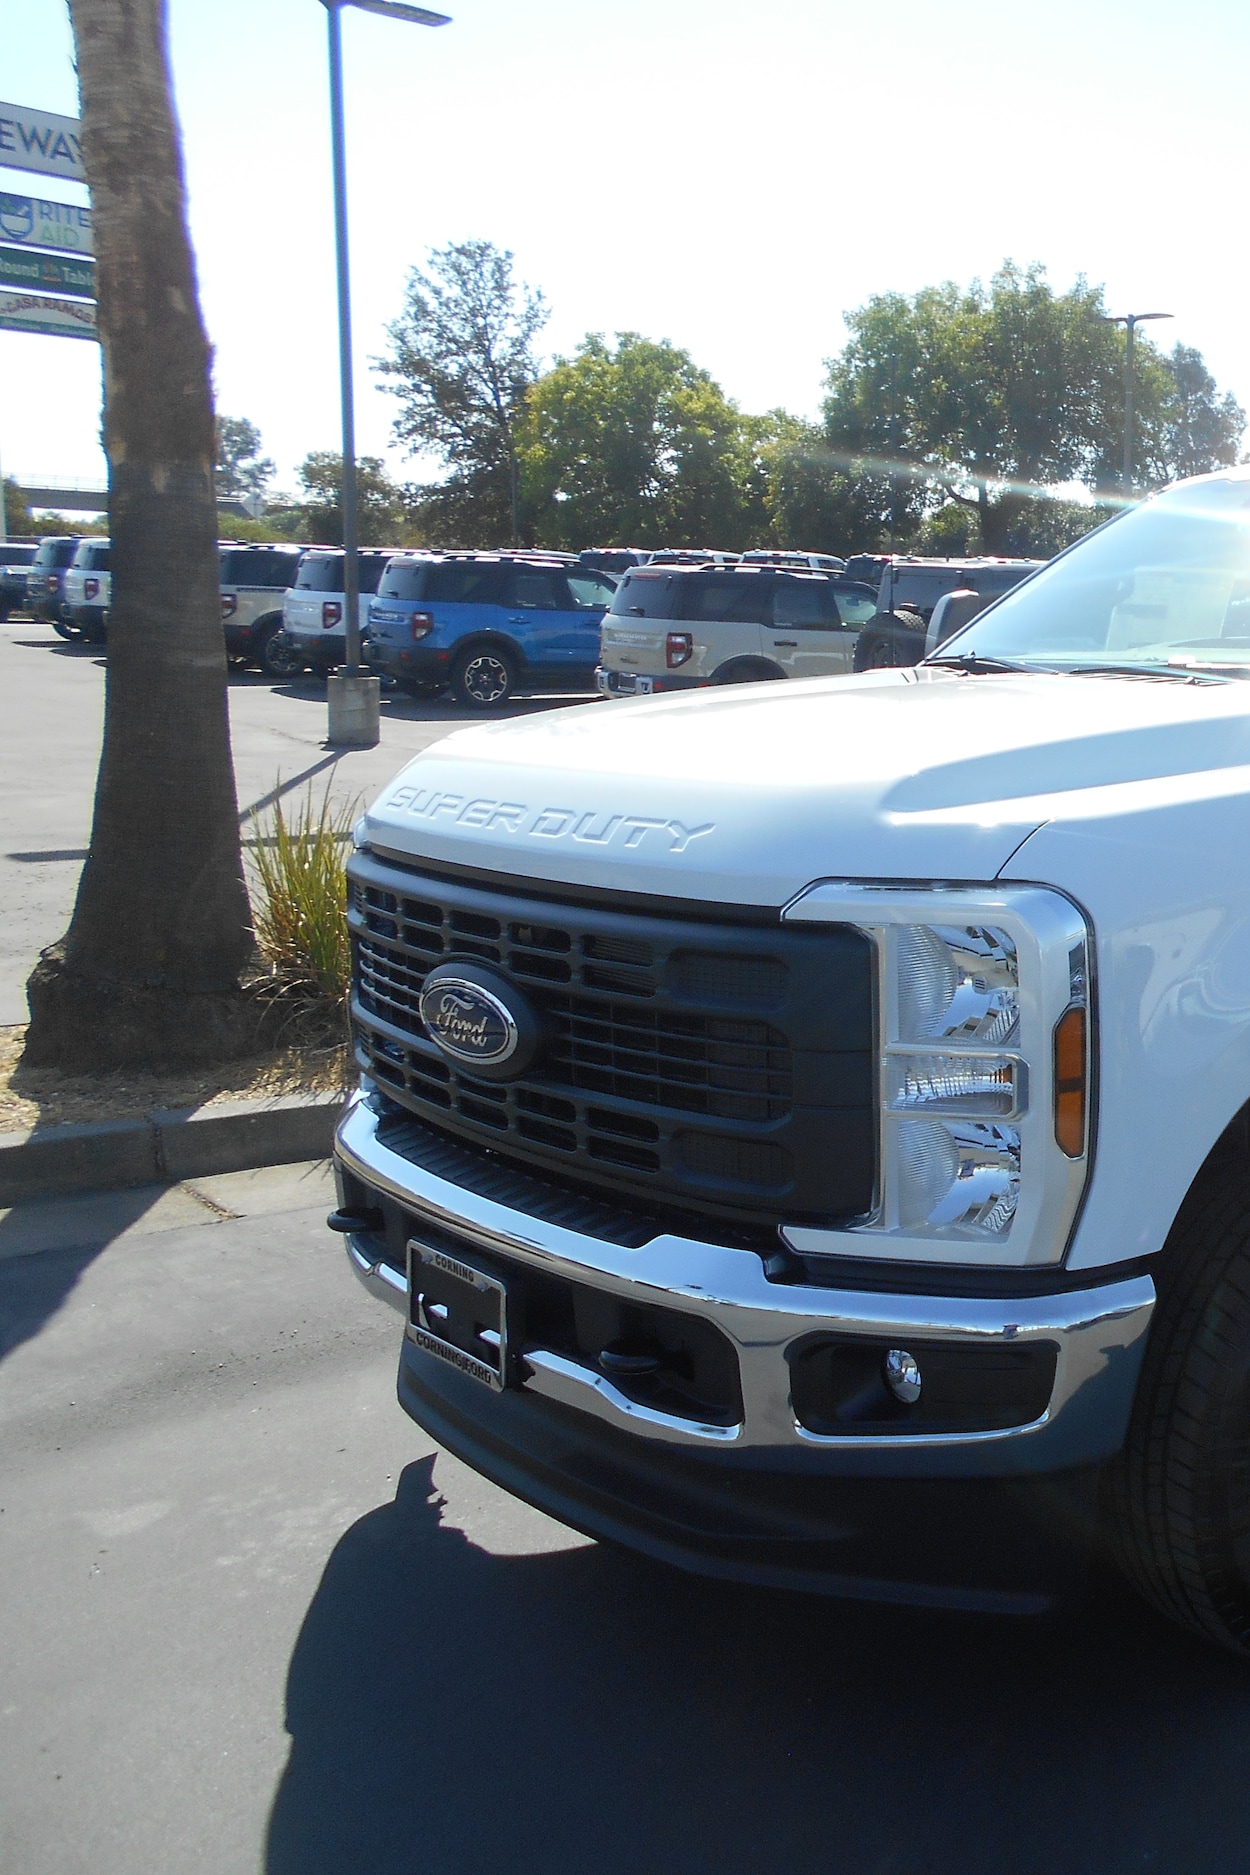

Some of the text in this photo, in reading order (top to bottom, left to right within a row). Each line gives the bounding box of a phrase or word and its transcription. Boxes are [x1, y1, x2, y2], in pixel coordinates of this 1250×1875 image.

[40, 202, 91, 228] RITE
[42, 225, 79, 247] AID
[0, 261, 94, 286] ound Tabl
[386, 786, 717, 852] SUPER DUTY
[437, 994, 488, 1047] Ford
[435, 1254, 475, 1283] CORNING
